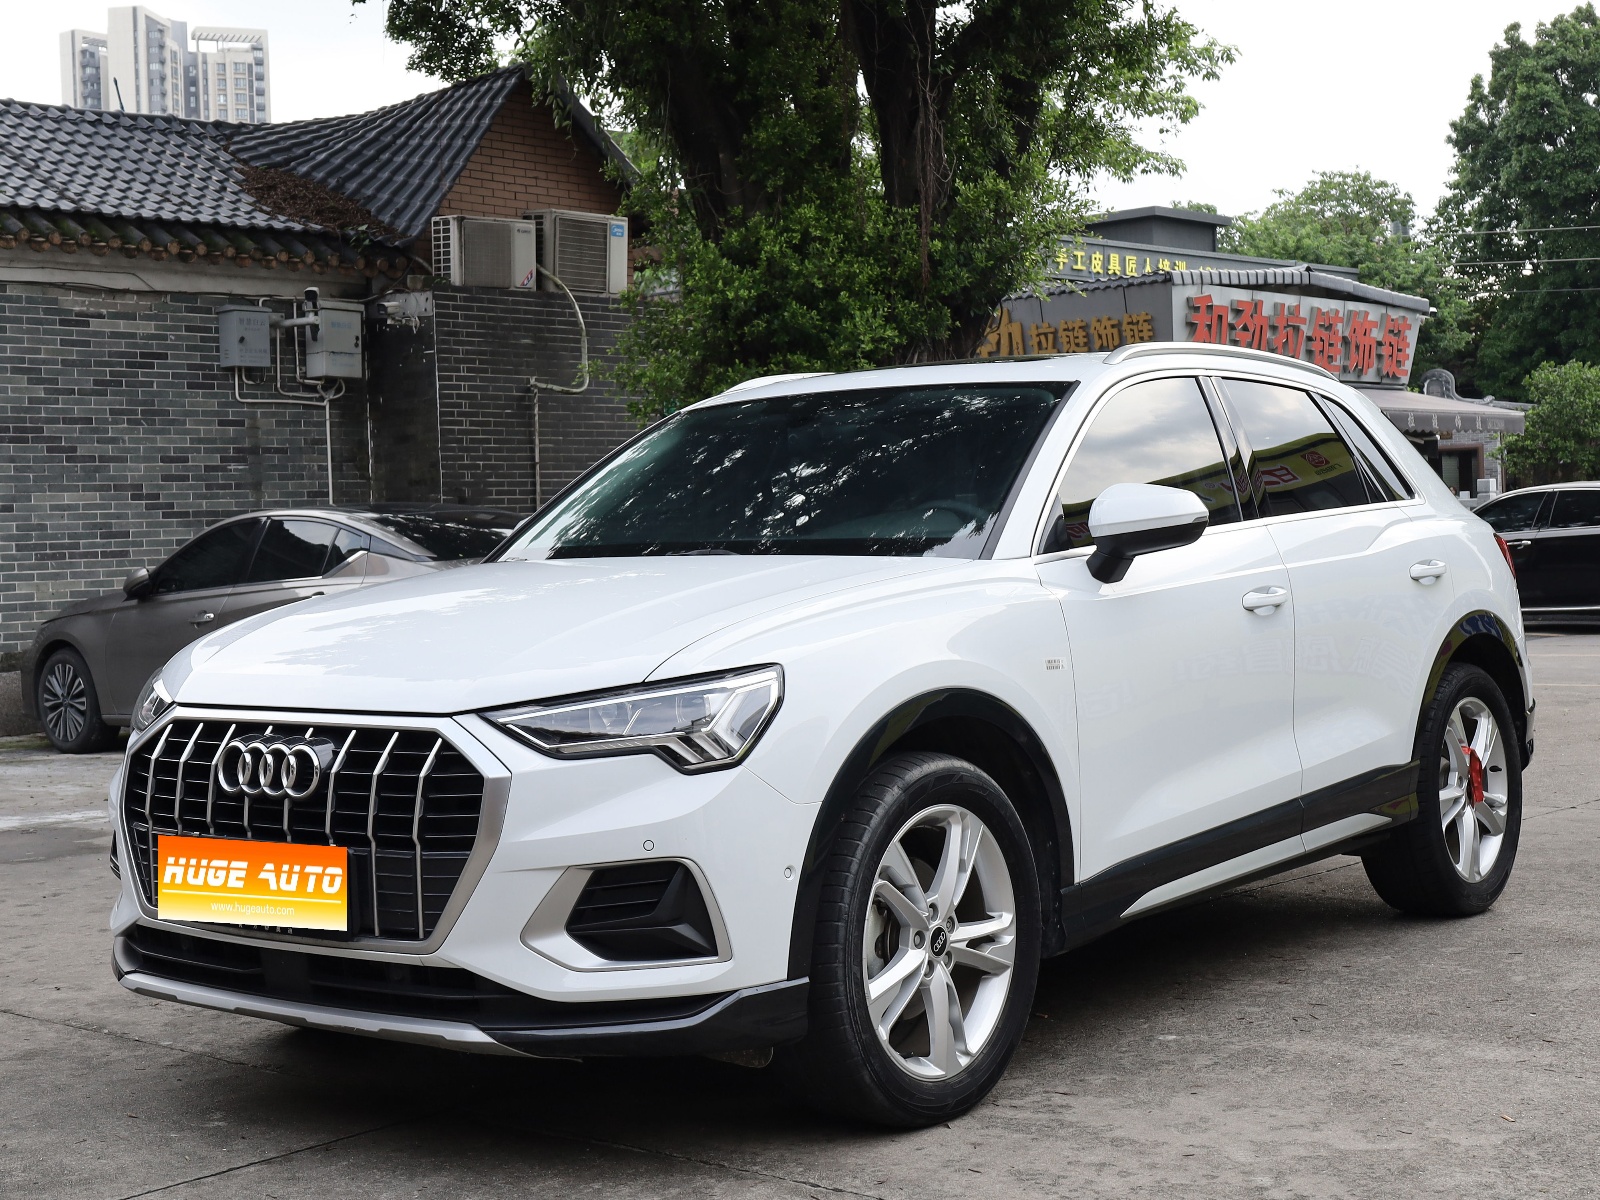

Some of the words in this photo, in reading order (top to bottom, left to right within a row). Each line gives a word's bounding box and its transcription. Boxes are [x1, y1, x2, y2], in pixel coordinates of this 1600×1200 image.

[1190, 293, 1411, 378] 和劲拉链饰链
